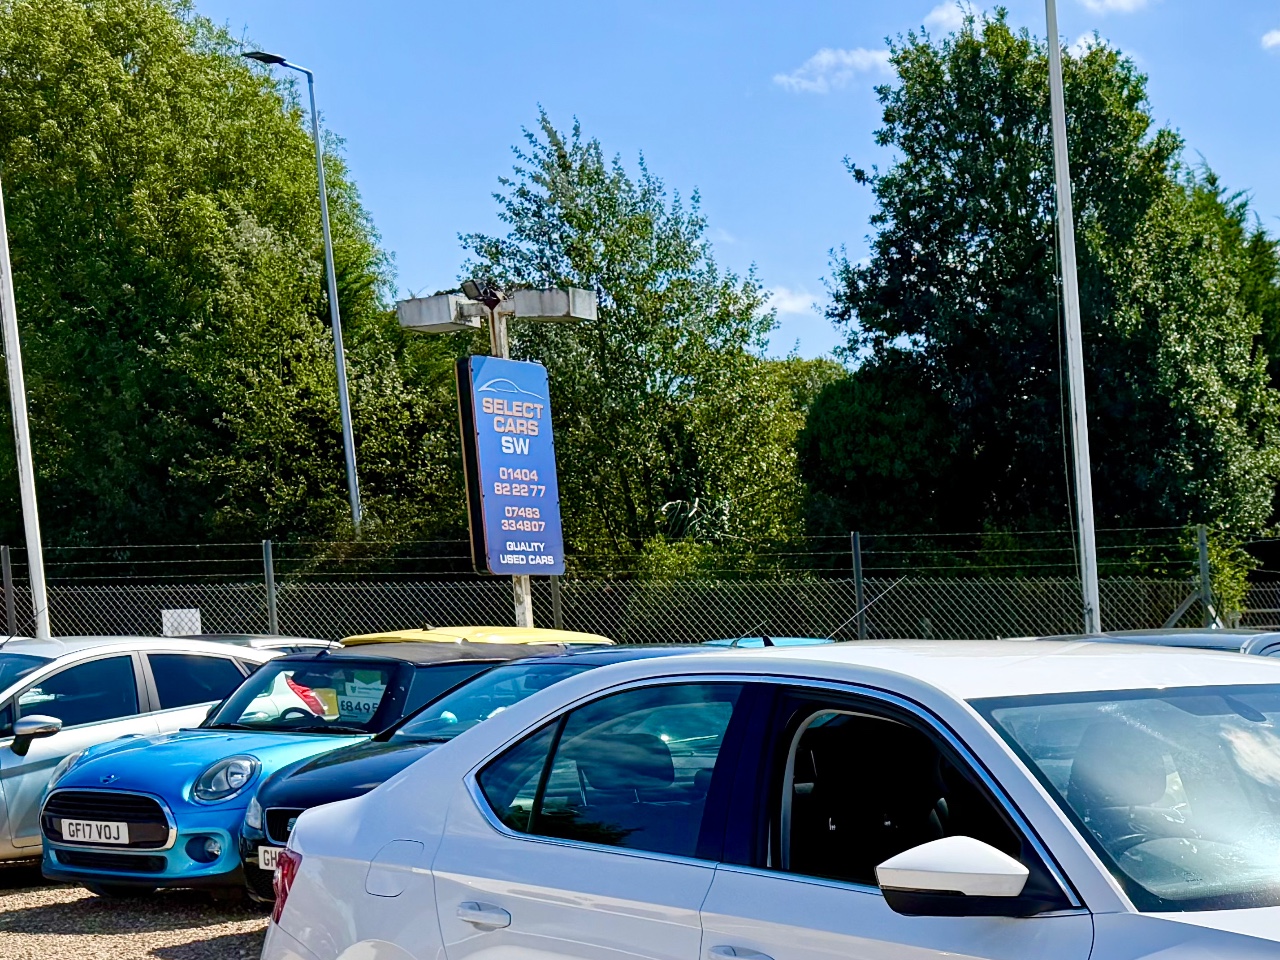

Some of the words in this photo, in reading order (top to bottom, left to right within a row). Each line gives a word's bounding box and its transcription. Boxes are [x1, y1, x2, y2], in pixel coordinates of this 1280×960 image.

[482, 397, 544, 419] SELECT
[493, 416, 539, 436] CARS
[501, 435, 530, 455] SW
[499, 466, 538, 481] 01404
[504, 506, 540, 518] 07483
[501, 519, 546, 532] 334807
[506, 541, 545, 552] QUALITY
[500, 554, 526, 564] USED
[528, 555, 555, 565] CARS
[68, 822, 92, 839] GF17
[95, 823, 120, 840] VOJ
[263, 849, 278, 867] GH
